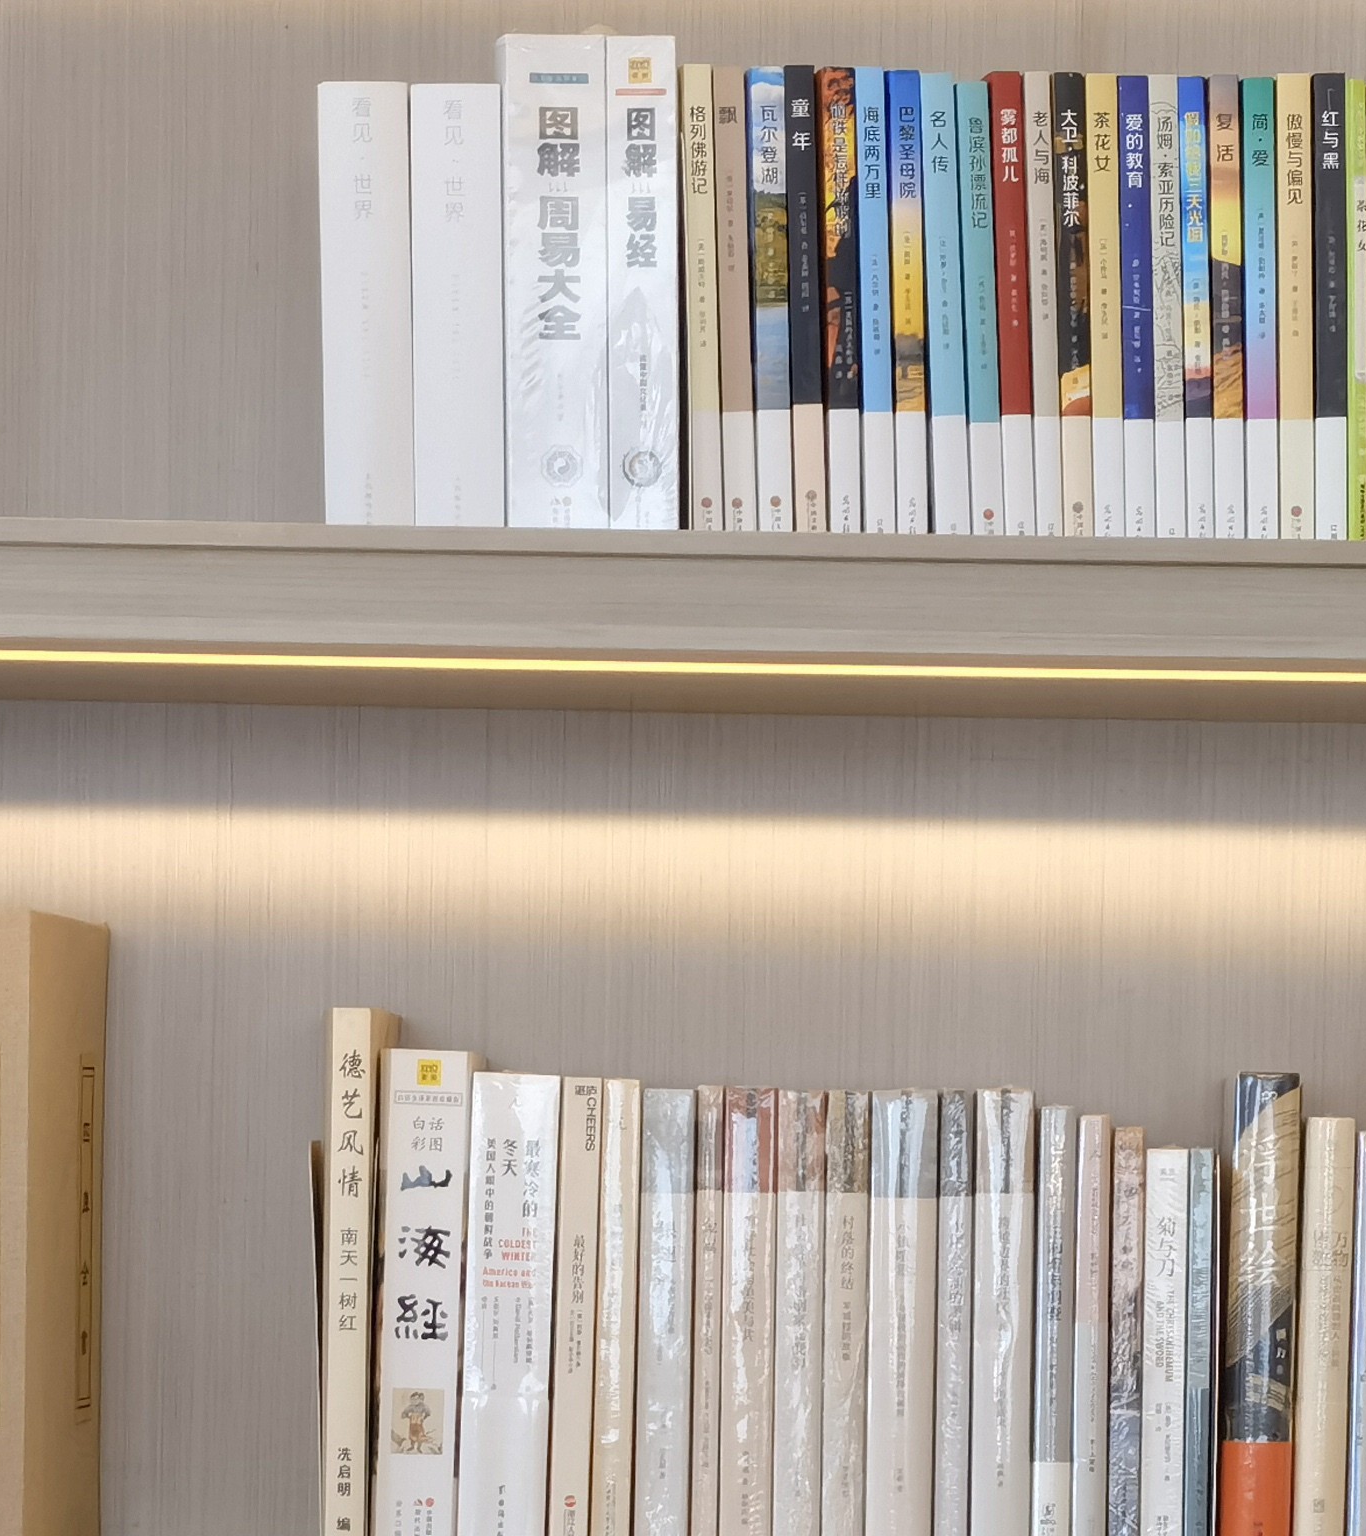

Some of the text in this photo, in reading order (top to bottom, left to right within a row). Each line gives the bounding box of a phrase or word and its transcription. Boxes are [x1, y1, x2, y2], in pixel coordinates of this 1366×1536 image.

[689, 106, 708, 195] 格列佛游记
[718, 106, 738, 125] 飘
[759, 105, 779, 185] 瓦尔登湖
[790, 98, 812, 151] 童年
[863, 106, 881, 200] 海底两万里
[899, 106, 917, 199] 巴黎圣母院
[930, 110, 949, 175] 名人传
[999, 108, 1020, 184] 雾都孤儿
[1032, 110, 1051, 186] 老人与海
[1092, 112, 1112, 173] 茶花女
[1124, 113, 1144, 189] 爱的教育
[1215, 112, 1235, 164] 复活
[1320, 110, 1341, 171] 红与黑
[968, 116, 989, 230] 鲁滨孙漂流记
[1060, 108, 1081, 228] 大卫·科波菲尔
[1155, 115, 1176, 248] 汤姆·索亚历险记
[1285, 113, 1304, 205] 傲慢与偏见
[336, 1051, 366, 1199] 德艺风情
[411, 1137, 444, 1152] 彩图
[412, 1116, 444, 1132] 白话
[501, 1138, 518, 1177] 冬天
[585, 1097, 598, 1152] CHEERS
[522, 1139, 541, 1218] 最寒冷的
[1237, 1136, 1281, 1289] 浮世绘
[338, 1227, 359, 1332] 南天一树红
[571, 1234, 586, 1304] 最好的告别
[840, 1214, 855, 1291] 村落的终结
[1157, 1216, 1178, 1278] 菊与刀
[335, 1515, 352, 1532] 编
